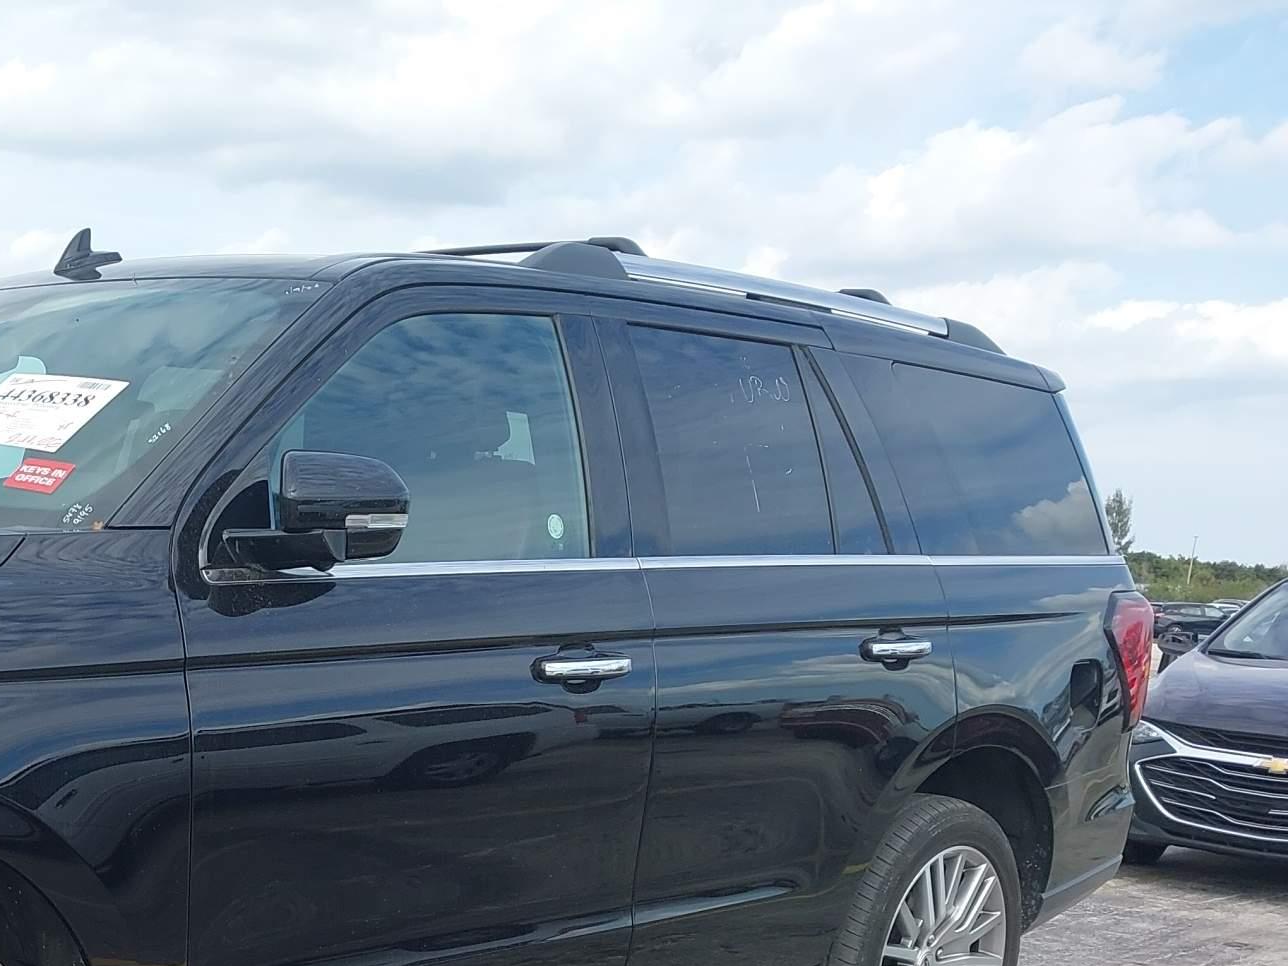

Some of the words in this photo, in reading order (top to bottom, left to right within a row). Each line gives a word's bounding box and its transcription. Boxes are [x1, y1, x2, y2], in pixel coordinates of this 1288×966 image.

[0, 388, 96, 408] 44368338
[19, 465, 51, 476] KEYS
[51, 468, 68, 479] IN
[14, 473, 57, 487] OFFICE
